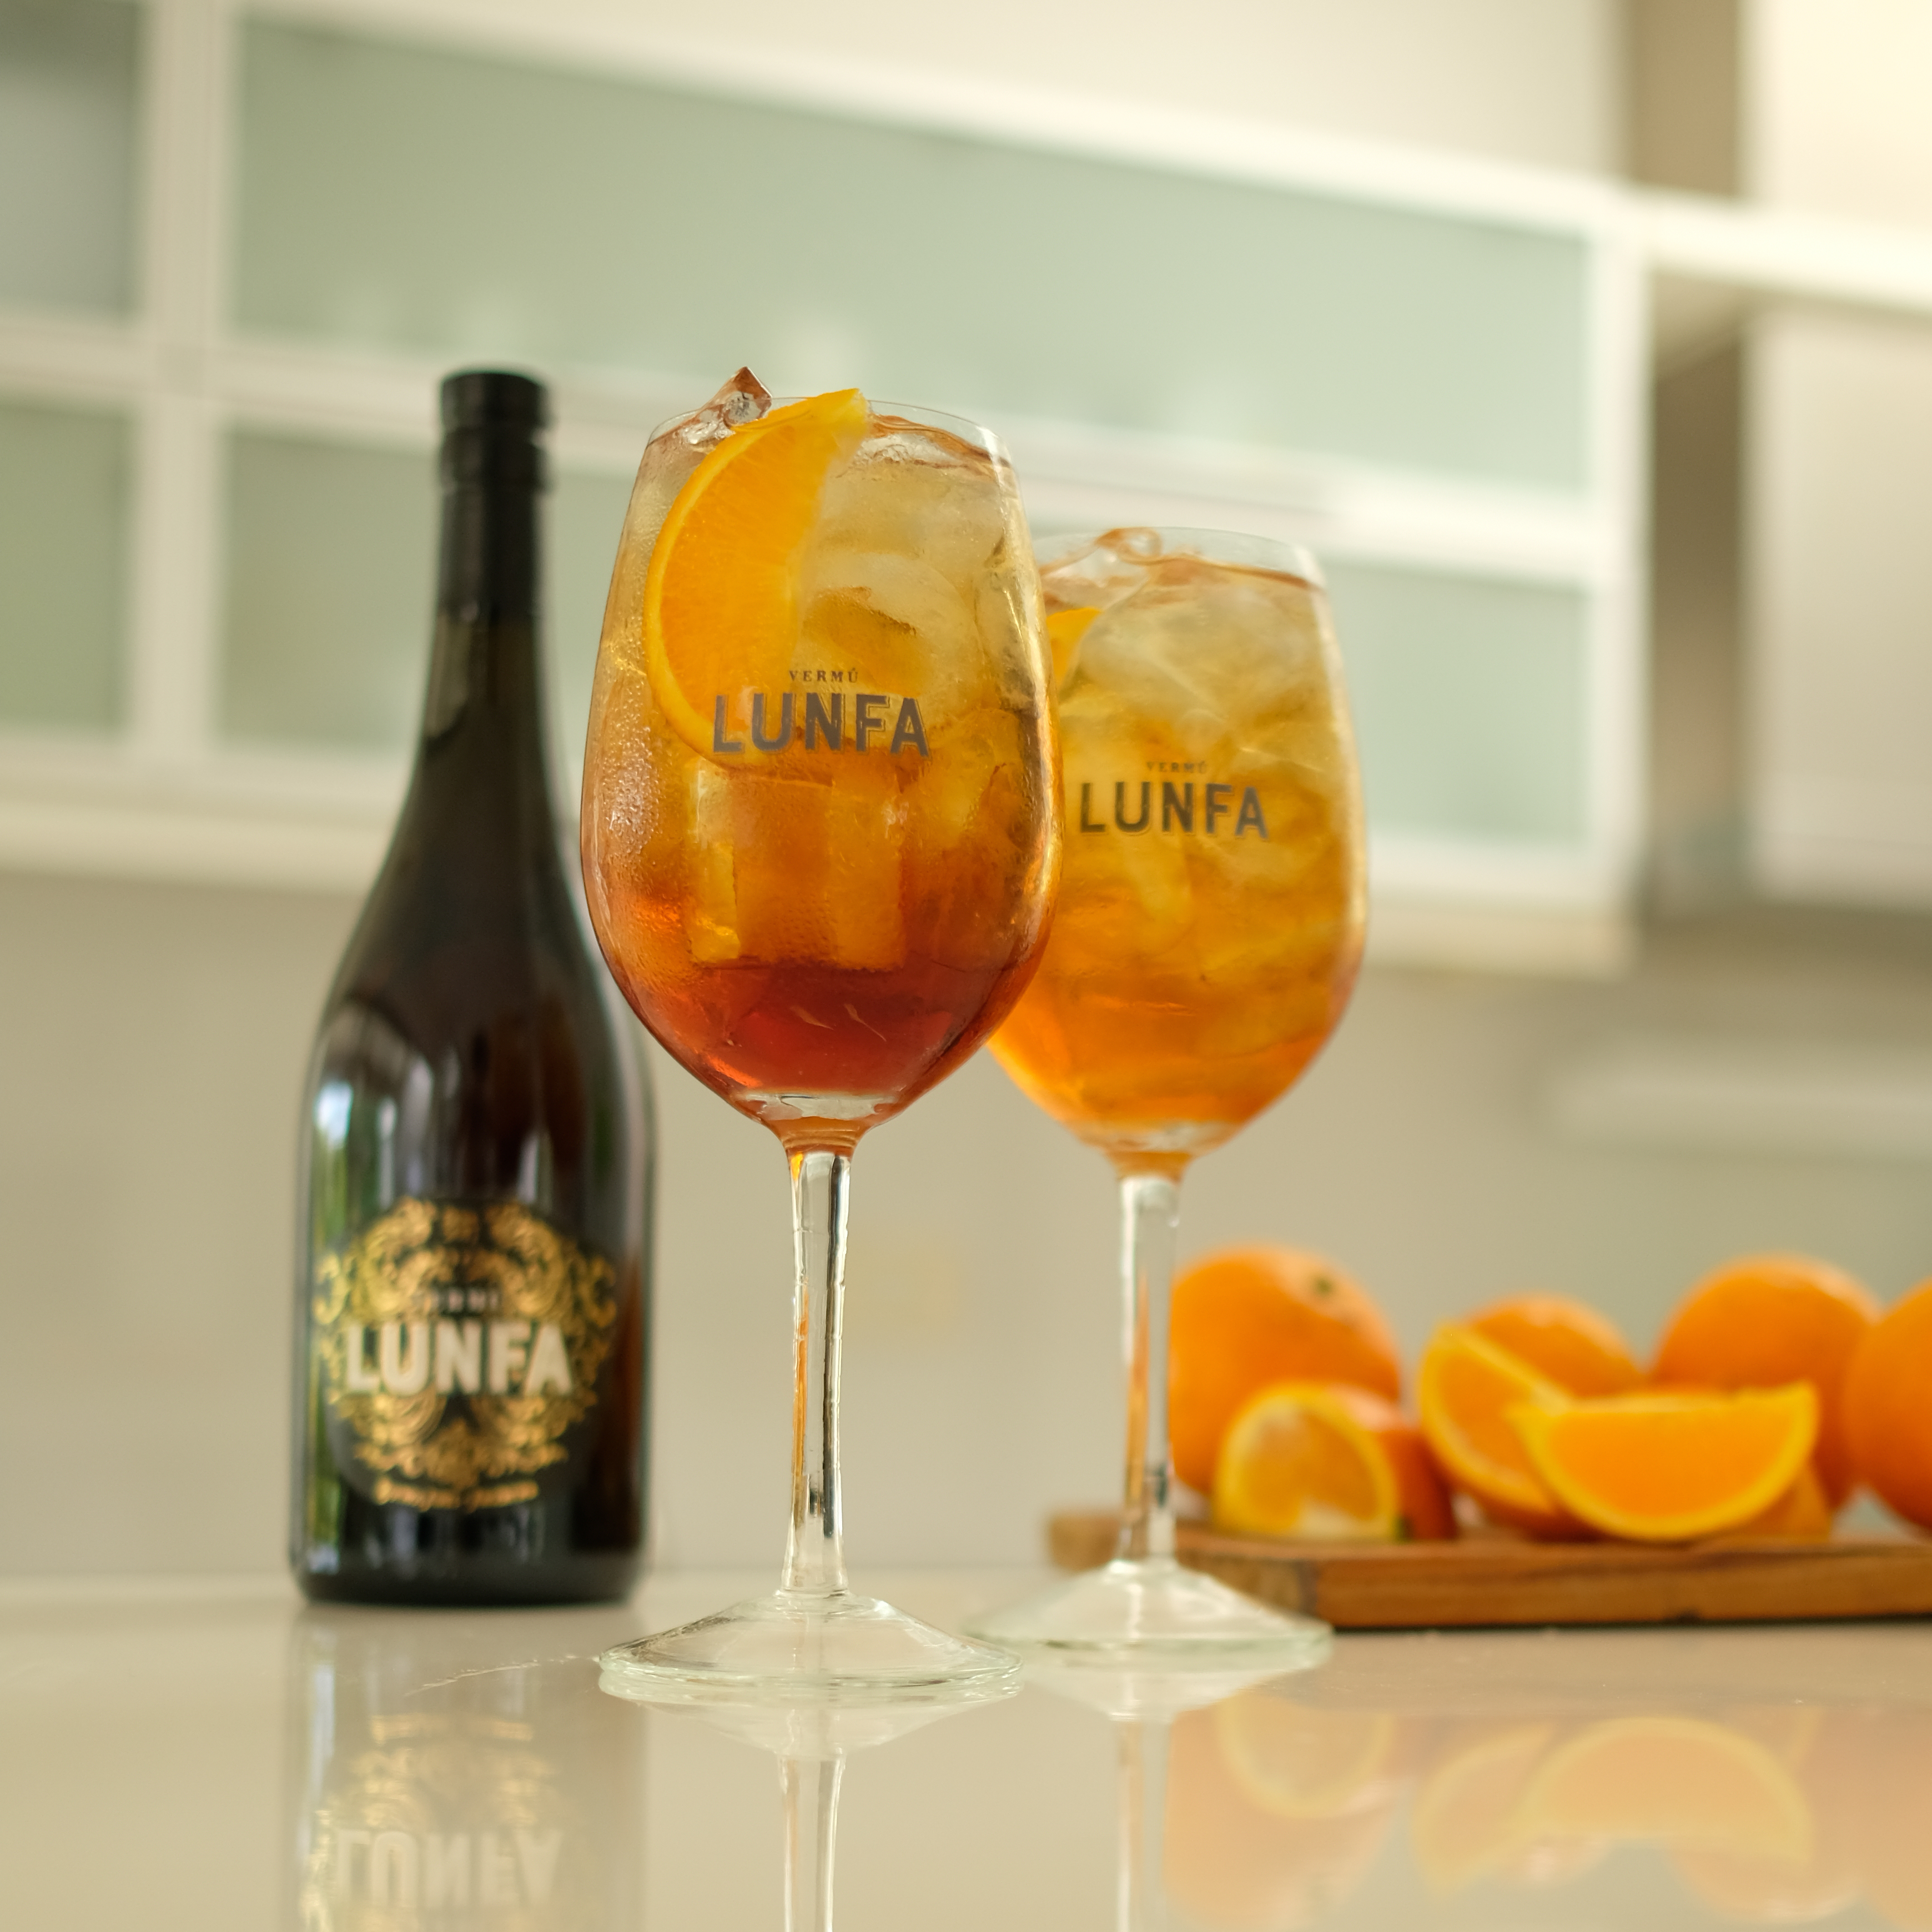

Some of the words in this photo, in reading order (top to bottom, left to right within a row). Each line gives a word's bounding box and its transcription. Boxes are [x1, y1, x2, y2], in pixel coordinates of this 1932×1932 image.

[789, 668, 858, 683] VERMÚ
[713, 692, 931, 758] LUNFA
[1146, 761, 1208, 774] VERMÚ
[1080, 781, 1269, 840] LUNFA
[345, 1321, 573, 1395] LUNFA
